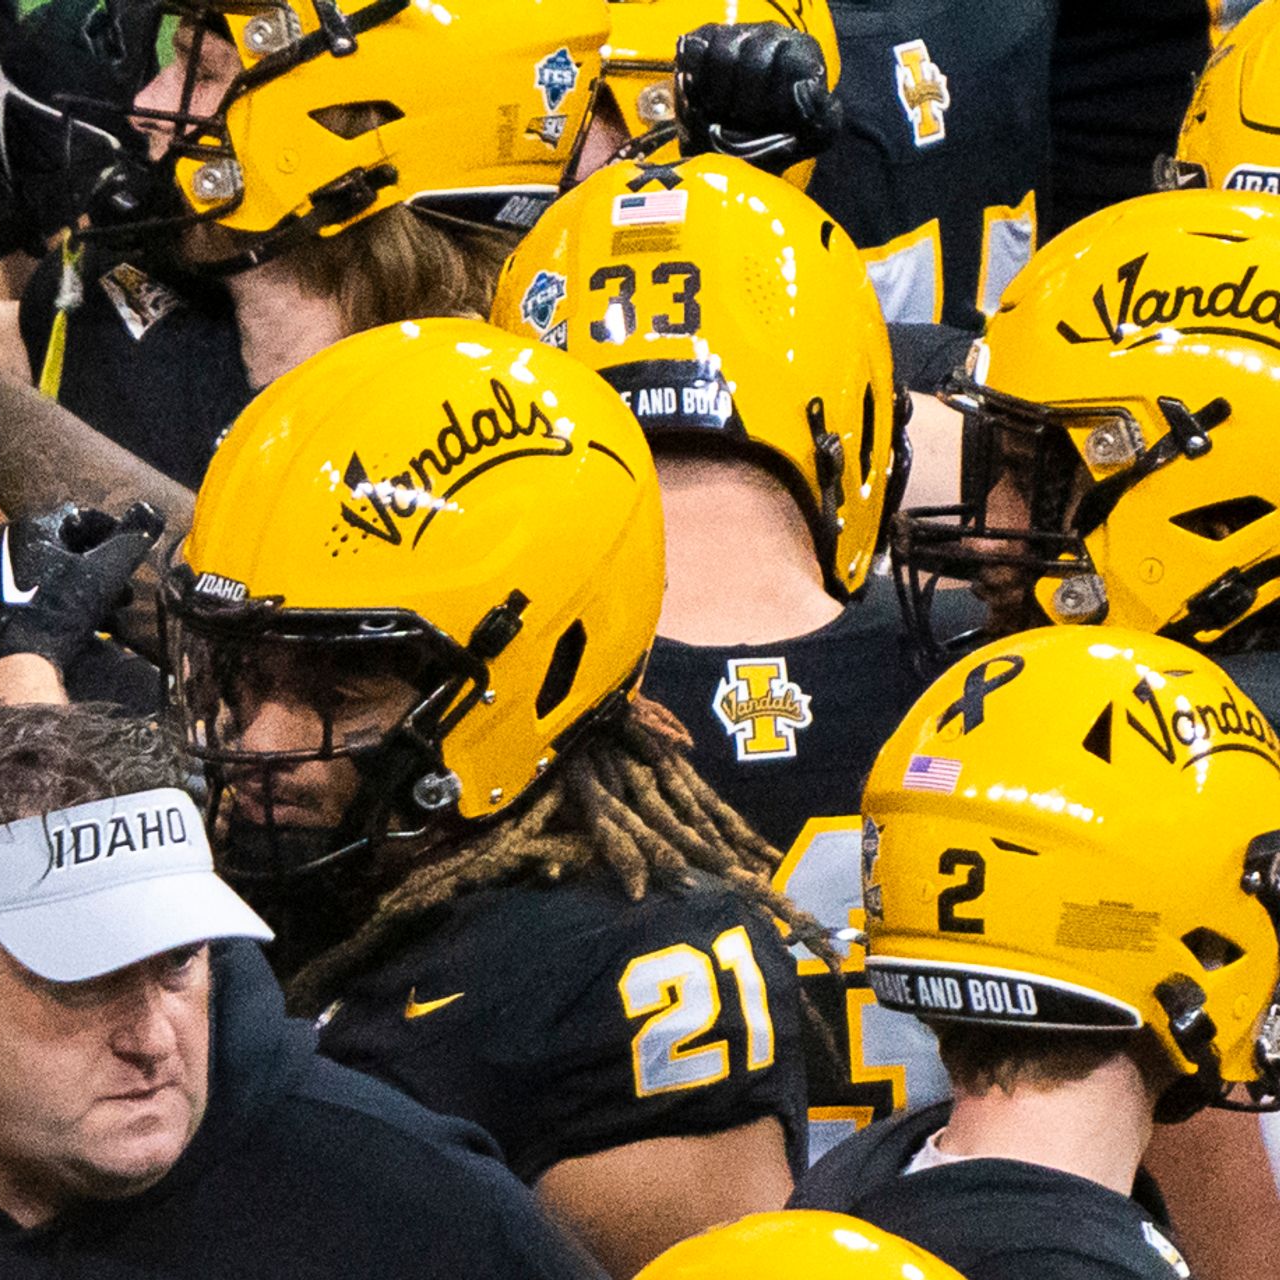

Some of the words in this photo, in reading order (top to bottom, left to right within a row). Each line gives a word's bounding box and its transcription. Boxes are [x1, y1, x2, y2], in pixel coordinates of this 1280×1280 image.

[589, 261, 701, 344] 33
[638, 388, 677, 416] AND
[339, 378, 557, 547] Vandals
[194, 572, 246, 602] IDAHO
[52, 805, 190, 871] IDAHO
[937, 847, 987, 935] 2
[618, 925, 775, 1099] 21
[917, 976, 964, 1010] AND
[968, 978, 1038, 1015] BOLD
